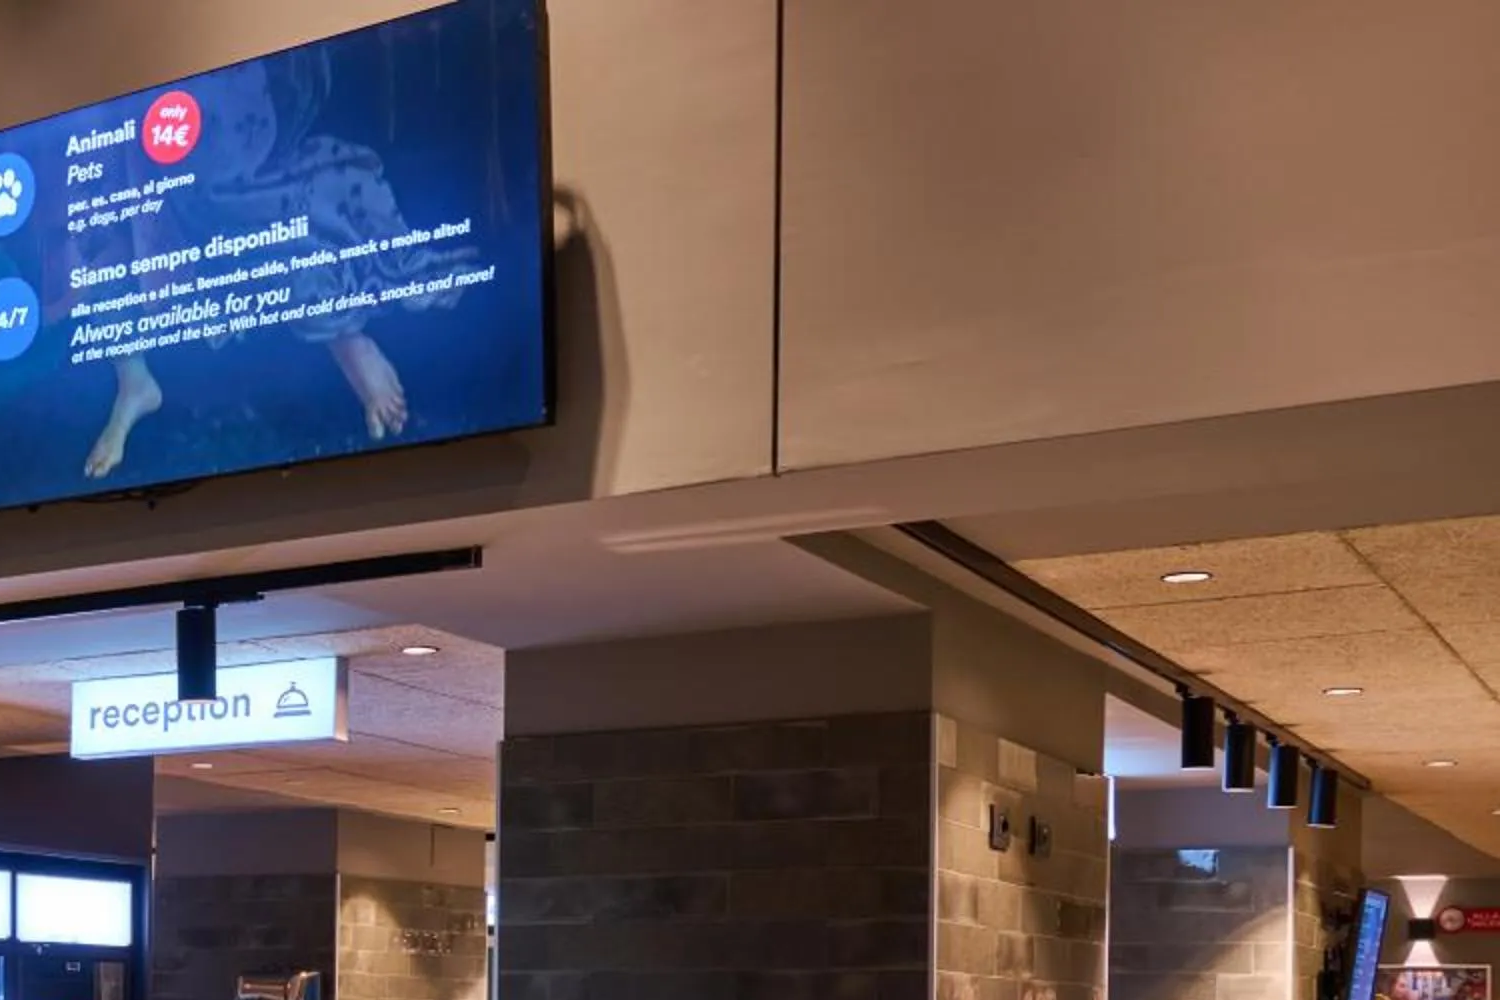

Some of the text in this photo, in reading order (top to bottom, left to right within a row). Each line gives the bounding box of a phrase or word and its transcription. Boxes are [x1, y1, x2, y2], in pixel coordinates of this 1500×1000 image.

[159, 104, 187, 121] only
[65, 119, 137, 157] Animali
[151, 123, 190, 148] 14€
[66, 162, 104, 186] Pets
[143, 182, 155, 196] al
[156, 173, 196, 195] giorno
[119, 204, 141, 222] per
[141, 198, 164, 215] day
[70, 215, 309, 289] Siamo sempre disponibili
[93, 290, 147, 315] reception
[197, 270, 249, 290] Bevande
[250, 260, 289, 280] calde,
[339, 239, 378, 260] snack
[391, 229, 431, 250] molto
[433, 217, 472, 240] altro!
[70, 288, 291, 348] Always available for you
[104, 335, 157, 359] reception
[157, 329, 180, 346] and
[229, 310, 257, 332] With
[259, 309, 279, 327] hot
[280, 303, 305, 322] and
[306, 298, 334, 317] cold
[335, 291, 378, 311] drinks,
[380, 280, 424, 302] snacks
[426, 273, 453, 293] and
[455, 265, 495, 288] more!
[90, 693, 251, 732] reception
